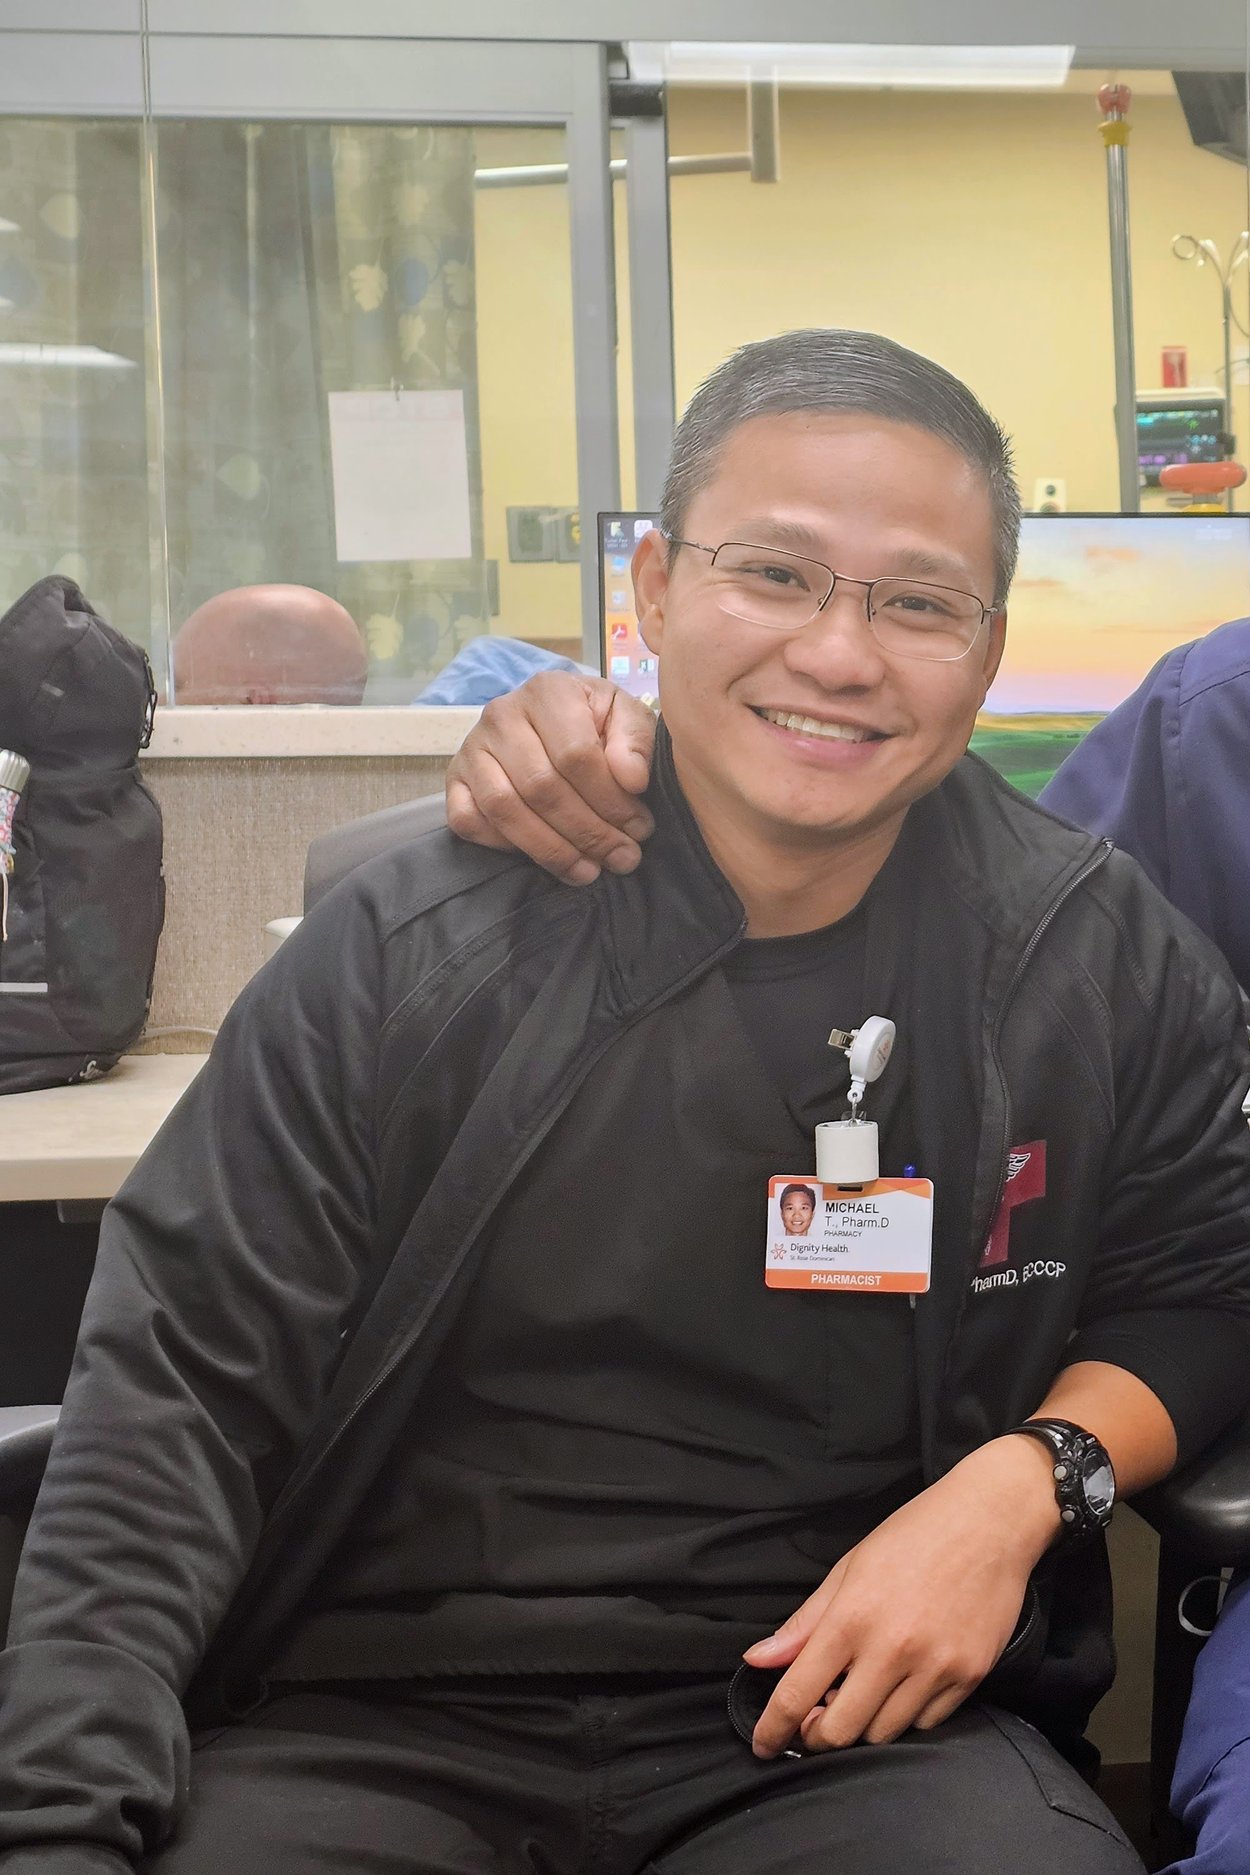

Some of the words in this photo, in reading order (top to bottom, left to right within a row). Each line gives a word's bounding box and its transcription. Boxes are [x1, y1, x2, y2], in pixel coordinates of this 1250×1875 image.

[825, 1202, 880, 1214] MICHAEL
[842, 1216, 890, 1228] Pharm.D
[824, 1230, 862, 1238] PHARMACY
[790, 1243, 820, 1254] Dignity
[821, 1244, 849, 1253] Health
[811, 1273, 882, 1286] PHARMACIST
